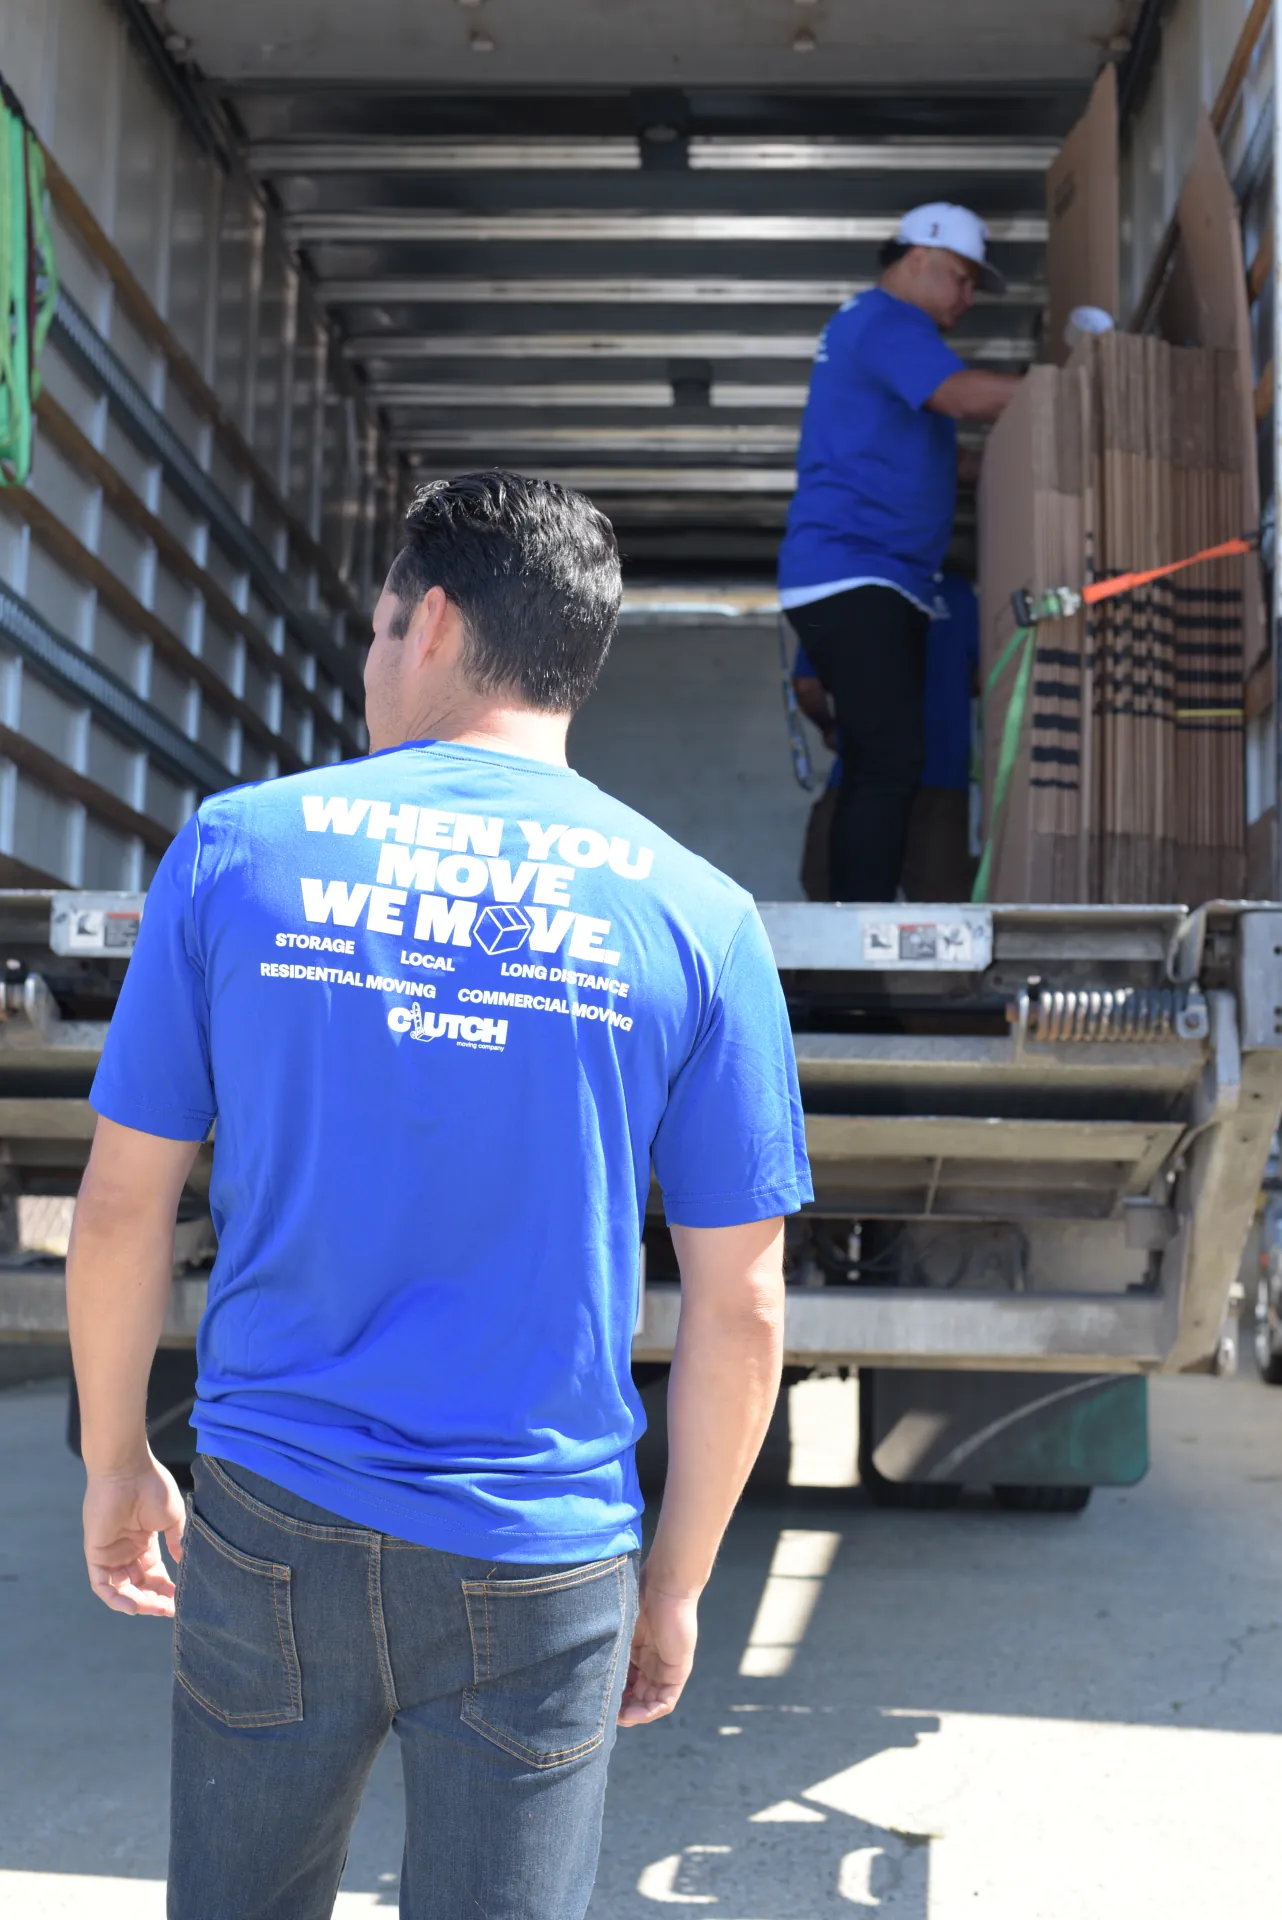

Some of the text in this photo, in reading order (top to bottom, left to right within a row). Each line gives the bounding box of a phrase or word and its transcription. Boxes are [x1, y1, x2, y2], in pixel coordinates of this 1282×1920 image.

[302, 796, 655, 880] WHEN YOU
[376, 843, 575, 907] MOVE
[301, 878, 407, 935] WE
[275, 932, 355, 955] STORAGE
[400, 950, 455, 972] LOCAL
[260, 962, 437, 999] RESIDENTIAL MOVING
[500, 962, 630, 998] LONG DISTANCE
[457, 988, 633, 1032] COMMERCIAL MOVNG
[456, 1041, 505, 1053] moving company
